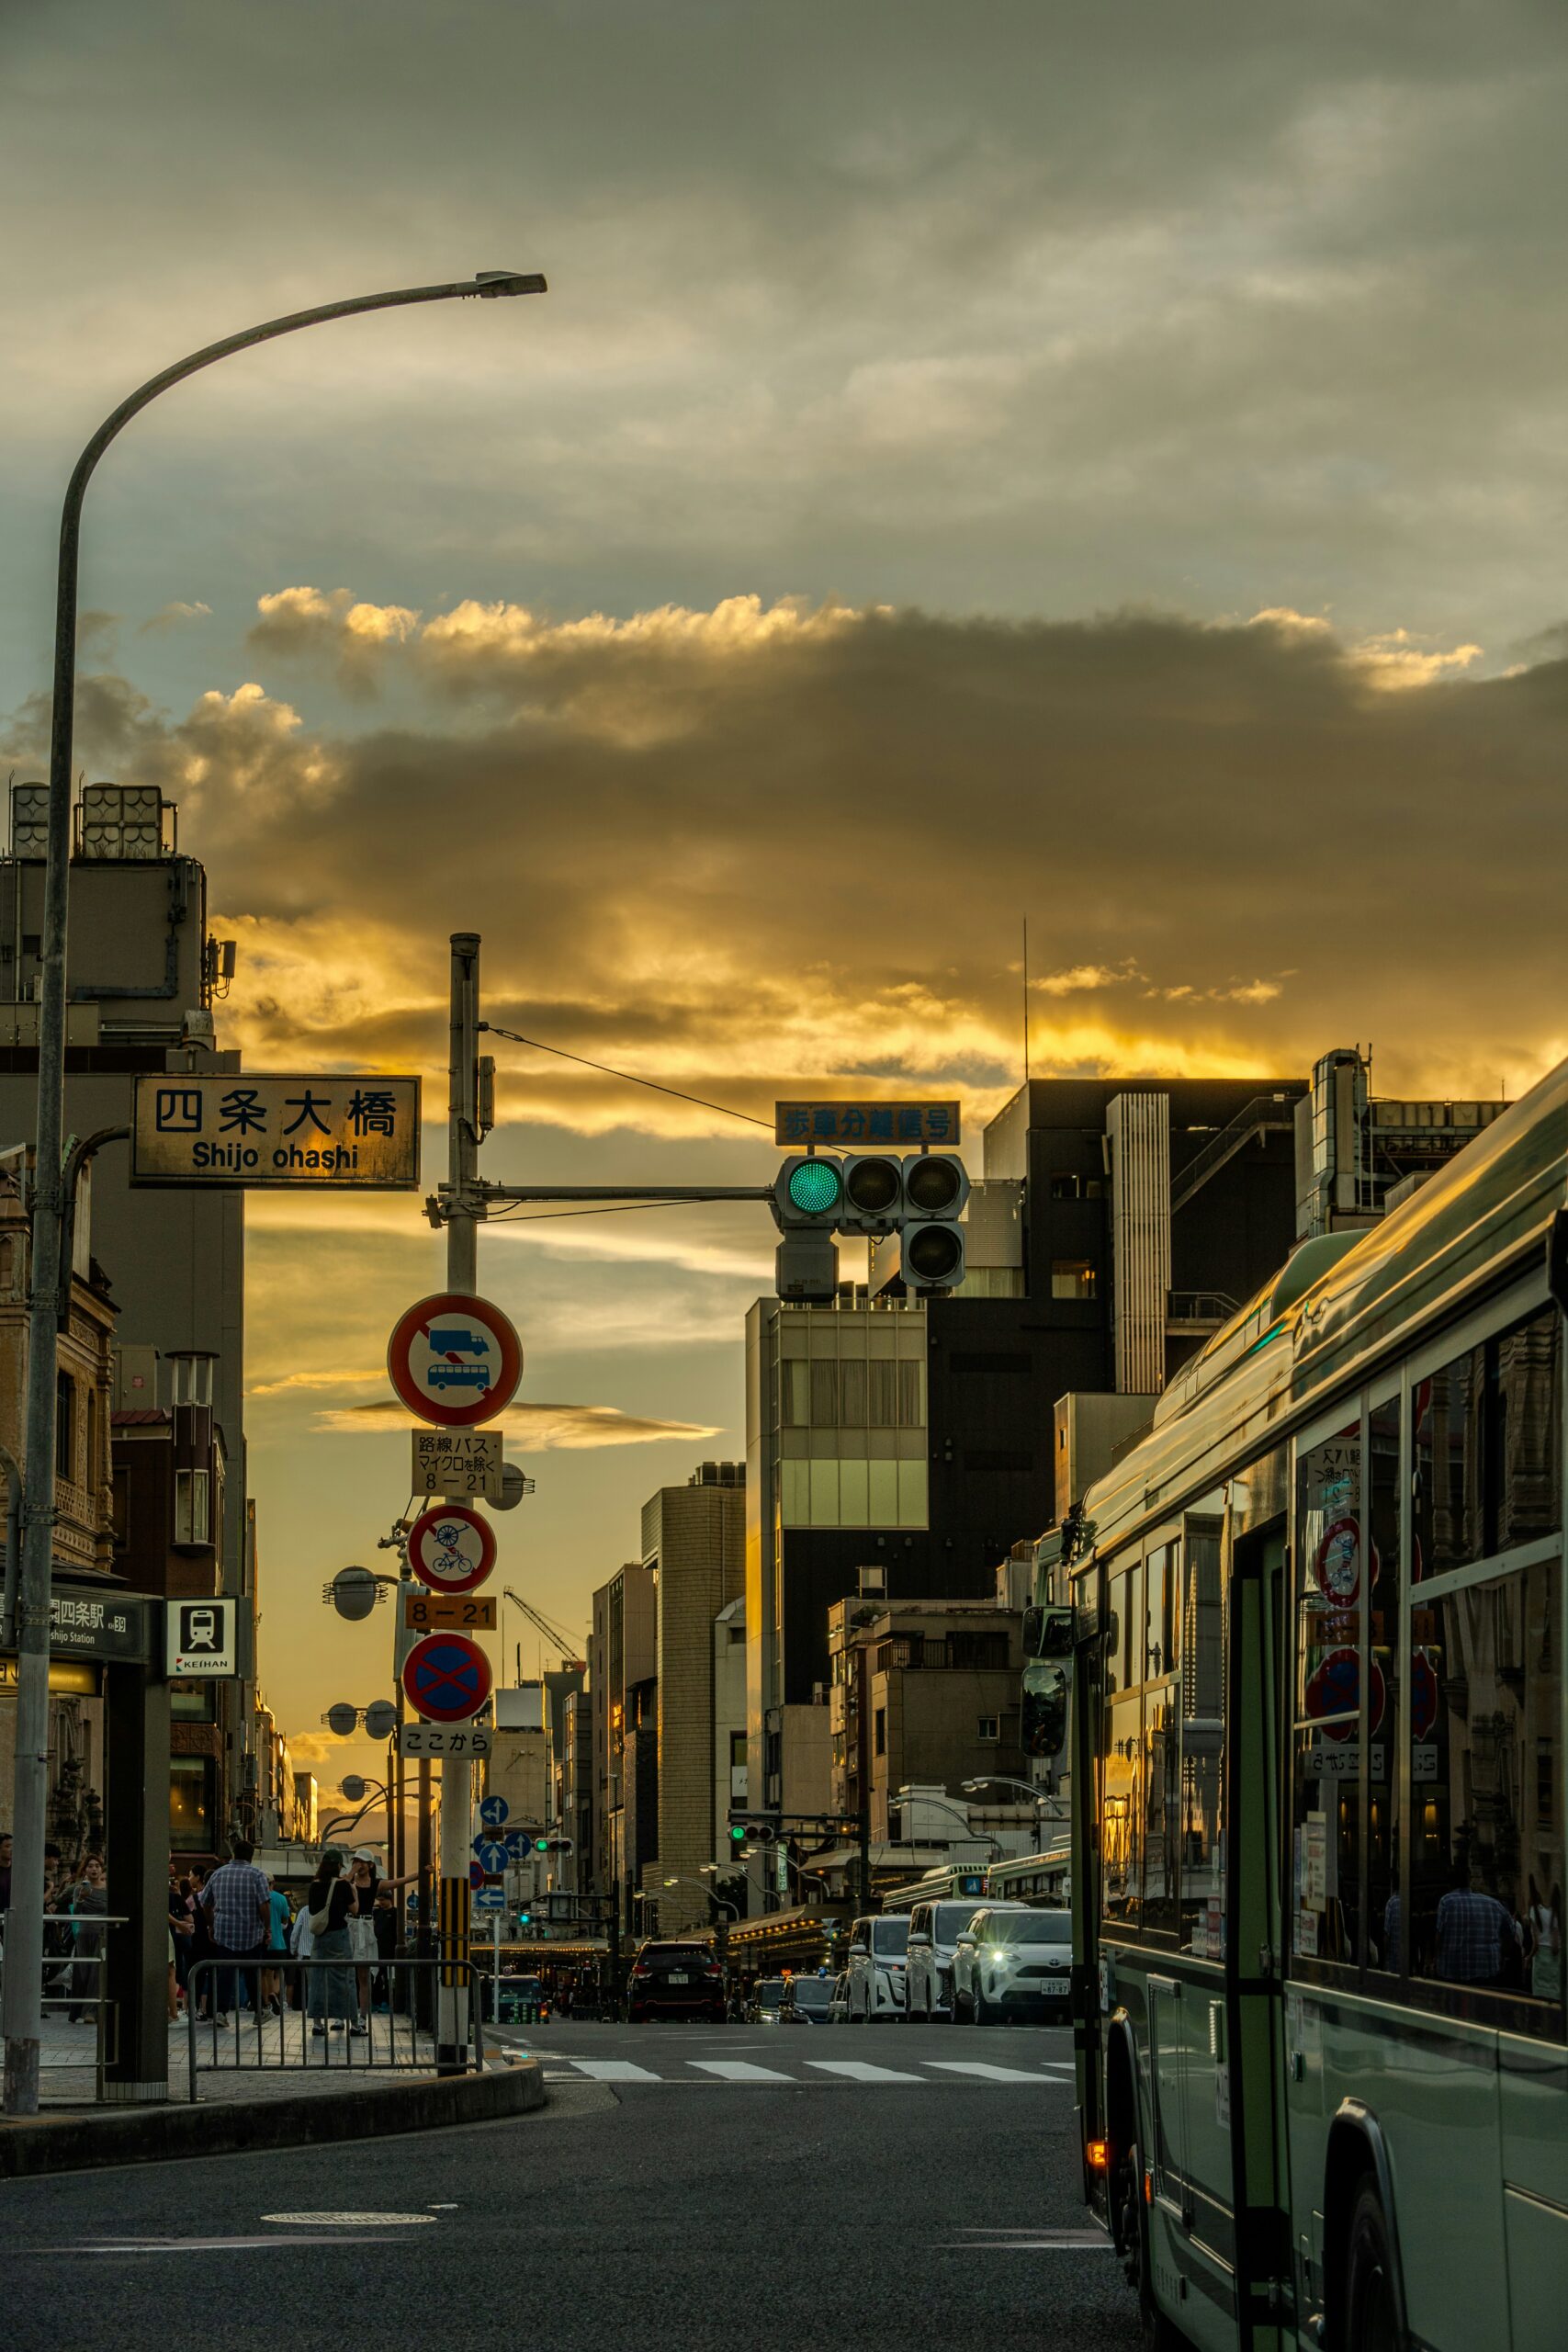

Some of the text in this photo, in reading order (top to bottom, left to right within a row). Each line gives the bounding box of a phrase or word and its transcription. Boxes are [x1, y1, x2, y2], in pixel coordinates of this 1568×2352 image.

[155, 1089, 397, 1138] 四条大橋
[784, 1108, 951, 1138] 歩車分離信号
[192, 1141, 358, 1172] Shijo ohashi
[418, 1455, 494, 1472] マイクロを除く
[49, 1599, 105, 1629] 園四条駅
[70, 1631, 96, 1645] Station
[184, 1659, 228, 1668] KEIHAN
[407, 1733, 489, 1752] ここから
